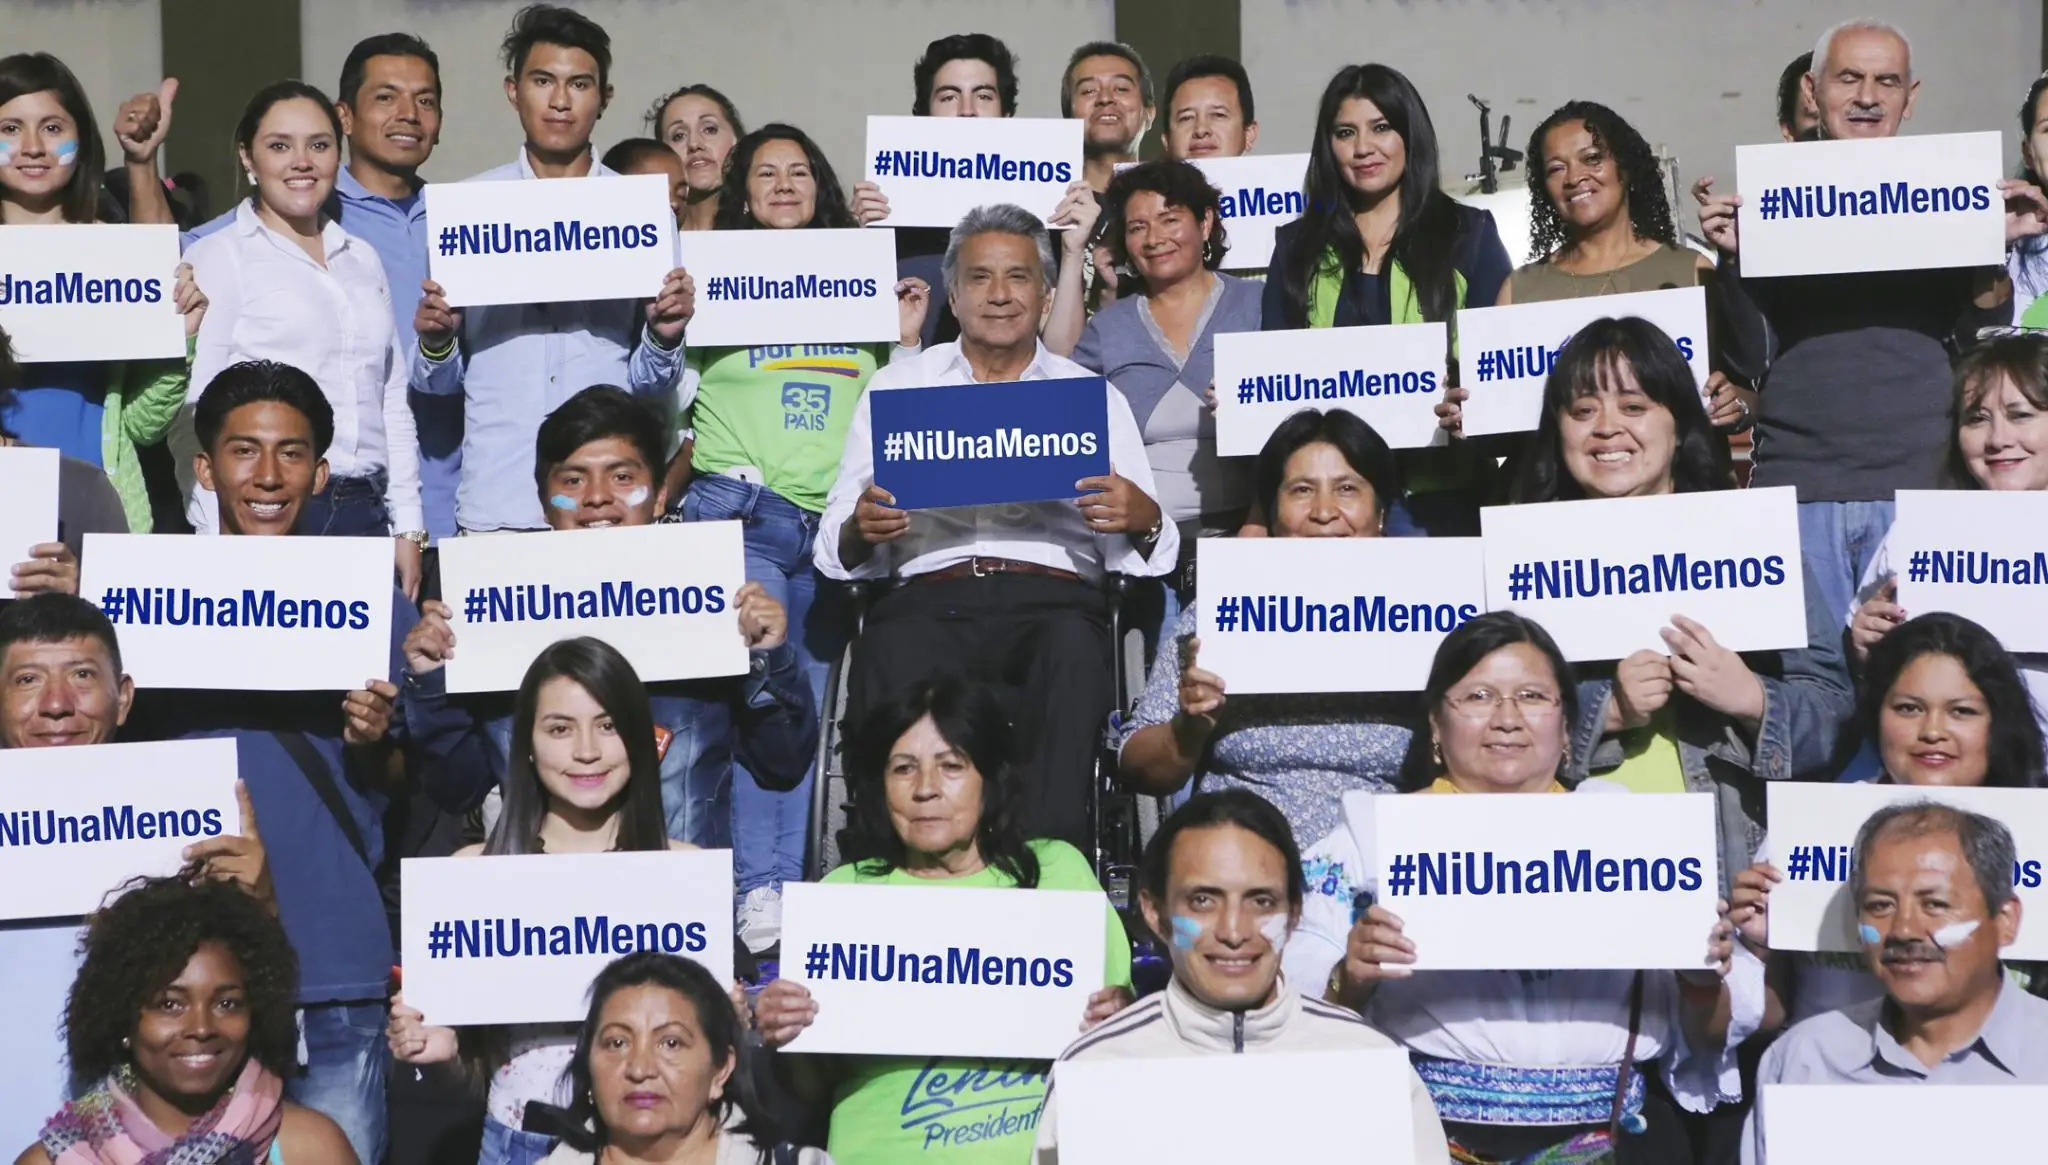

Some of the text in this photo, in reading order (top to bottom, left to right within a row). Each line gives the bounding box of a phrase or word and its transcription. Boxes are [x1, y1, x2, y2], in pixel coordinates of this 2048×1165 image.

[874, 151, 1072, 183] #NiUnaMenos
[1760, 182, 1990, 220] #NiUnaMenos
[439, 221, 658, 257] #NiUnaMenos
[707, 274, 877, 301] #NiUnaMenos
[784, 386, 826, 414] 35
[1237, 369, 1437, 404] #NiUnaMenos
[784, 411, 825, 431] PAIS
[884, 427, 1097, 461] #NiUnaMenos
[1508, 553, 1785, 601] #NiUnaMenos
[100, 587, 370, 630] #NiUnaMenos
[464, 580, 726, 623] #NiUnaMenos
[1215, 595, 1478, 634] #NiUnaMenos
[0, 805, 223, 847] NiUnaMenos
[1388, 849, 1703, 897] #NiUnaMenos
[429, 915, 707, 959] #NiUnaMenos
[805, 943, 1073, 988] #NiUnaMenos
[924, 1101, 1043, 1150] President
